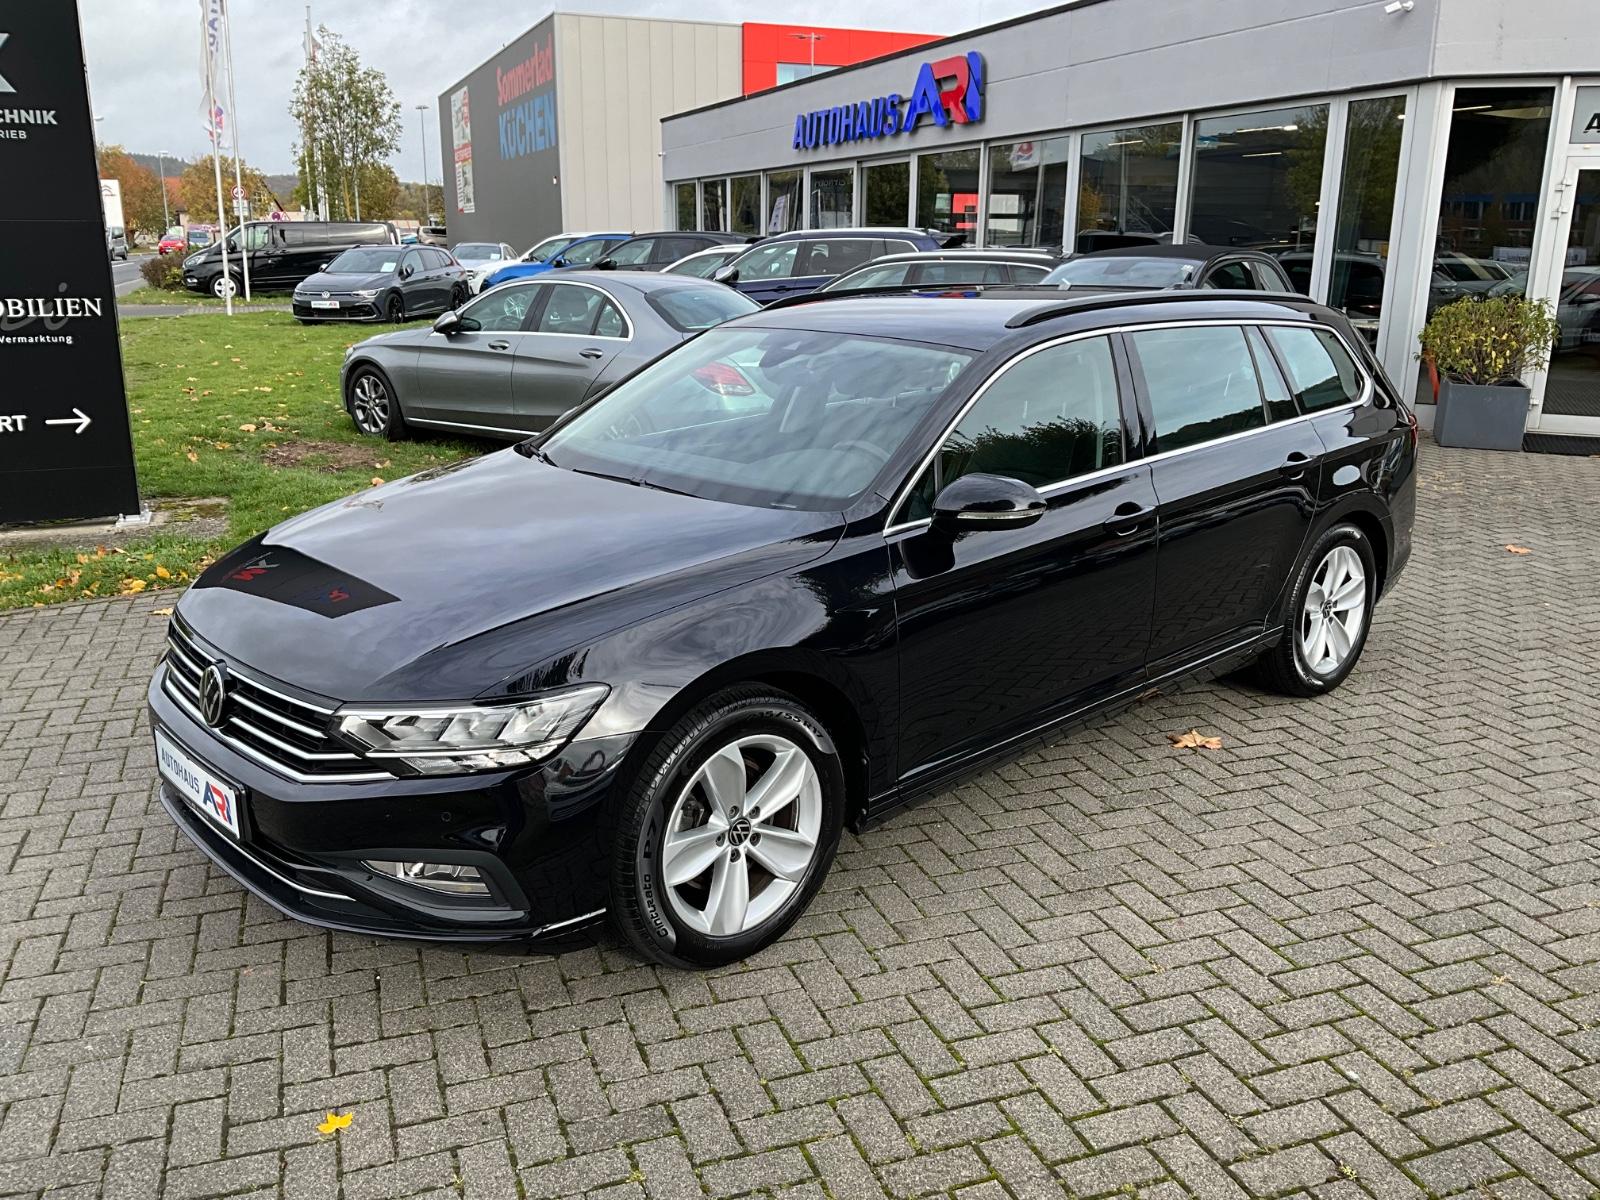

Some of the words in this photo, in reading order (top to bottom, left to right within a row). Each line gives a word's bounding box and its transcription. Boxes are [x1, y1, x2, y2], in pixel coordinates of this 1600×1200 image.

[496, 32, 553, 107] Sommerlad
[498, 90, 556, 161] KÜCHEN
[793, 94, 900, 150] AUTOHAUS
[161, 747, 201, 795] AUTOHAUS
[643, 873, 669, 938] Cinturato
